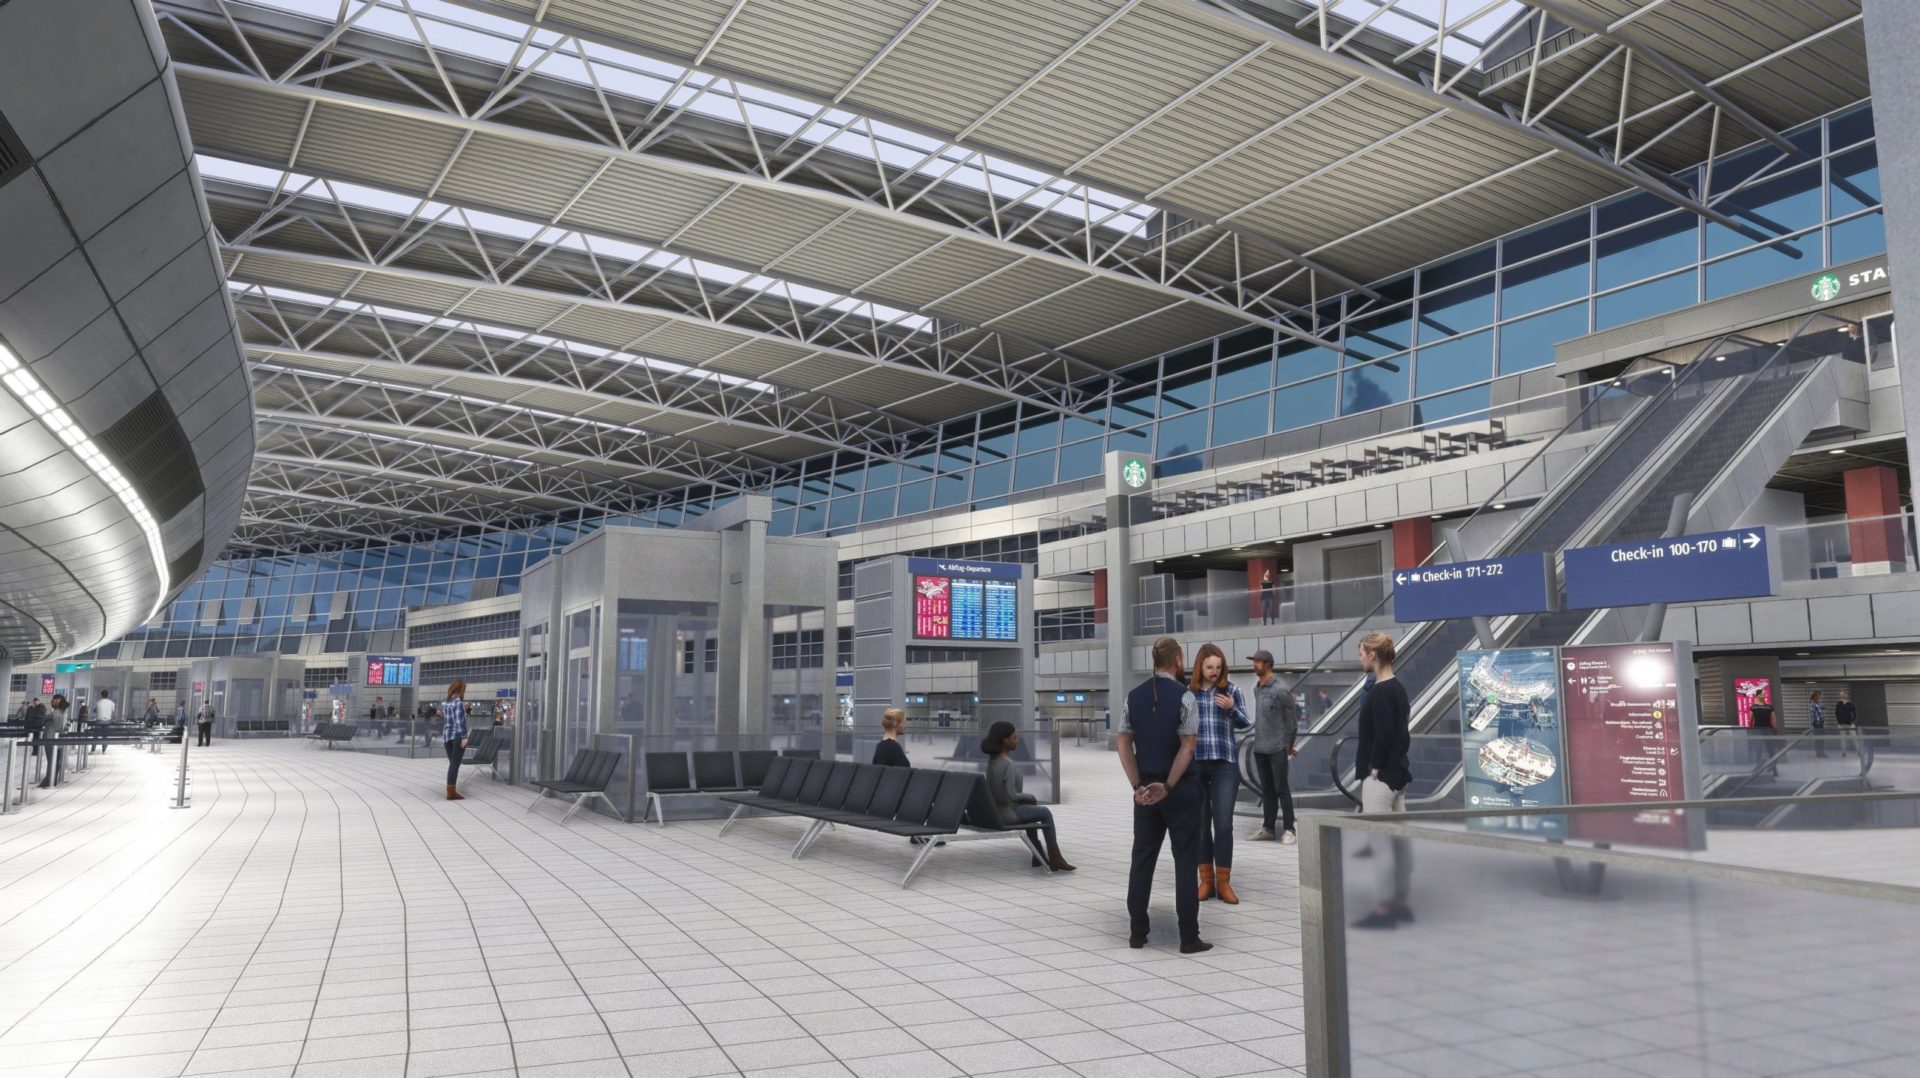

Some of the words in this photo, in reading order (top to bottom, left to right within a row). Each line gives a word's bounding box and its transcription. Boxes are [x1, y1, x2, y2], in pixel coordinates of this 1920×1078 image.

[1849, 266, 1890, 286] STA
[1611, 545, 1664, 563] Check-in
[1669, 539, 1718, 556] 100-170
[1422, 568, 1462, 583] Check-in
[1466, 564, 1504, 578] 171-272
